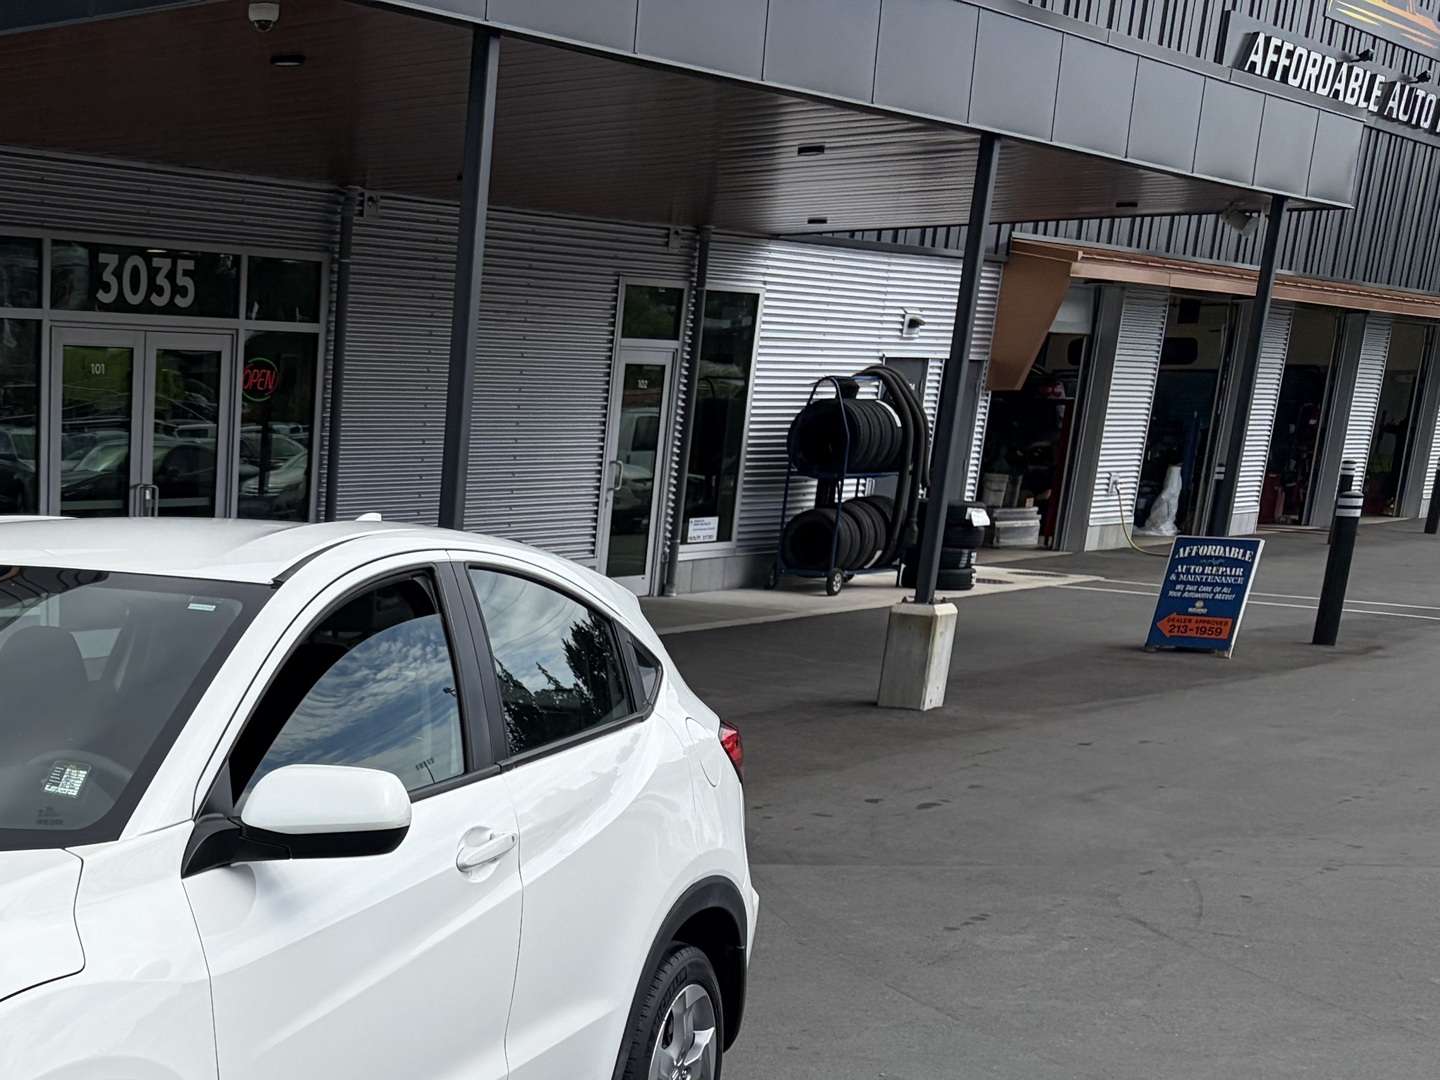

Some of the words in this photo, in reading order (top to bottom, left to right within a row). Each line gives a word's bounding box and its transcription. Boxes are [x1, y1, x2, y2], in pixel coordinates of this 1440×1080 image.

[1244, 32, 1386, 113] AFFORDABLE
[1384, 82, 1437, 129] AUTO
[96, 252, 195, 308] 3035
[91, 363, 105, 375] 101
[1175, 545, 1254, 562] AFFORDABLE
[1174, 564, 1202, 573] AUTO
[1204, 566, 1244, 576] REPAIR
[1179, 574, 1244, 584] MAINTENANCE
[1168, 624, 1223, 636] 213-1959
